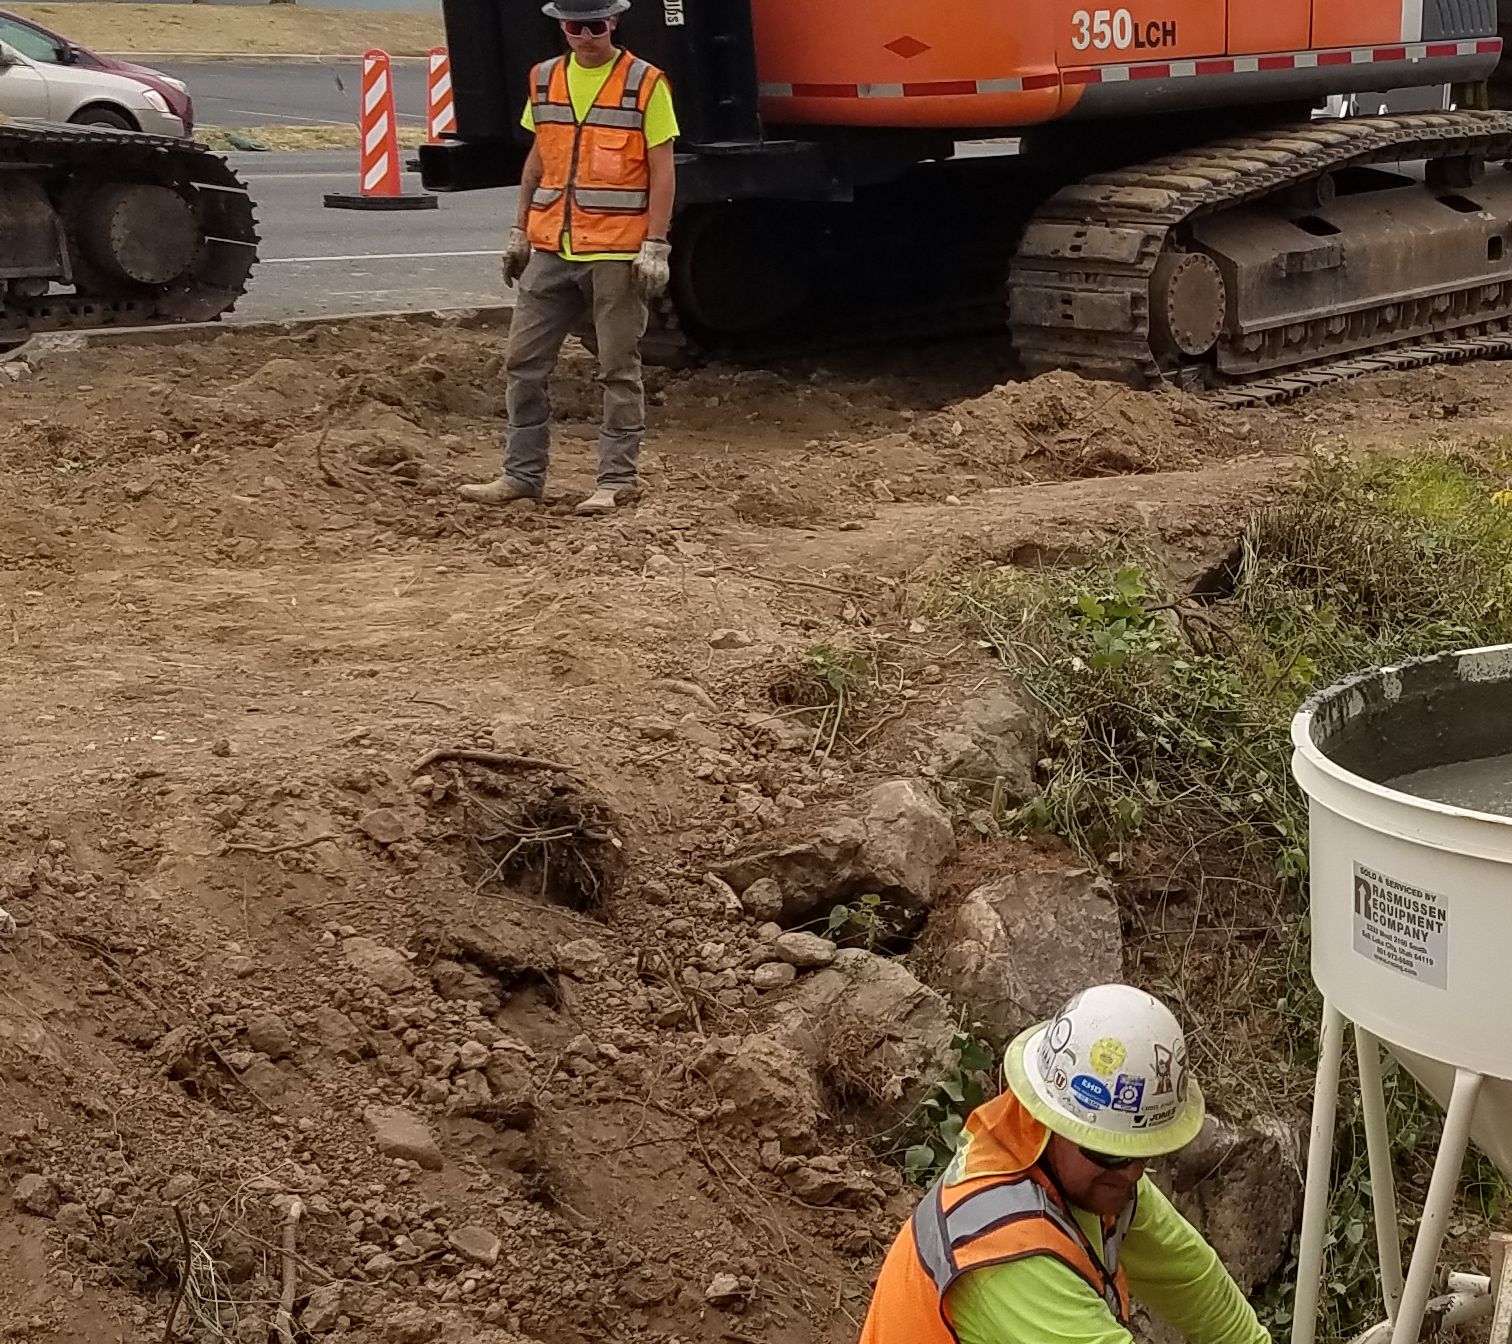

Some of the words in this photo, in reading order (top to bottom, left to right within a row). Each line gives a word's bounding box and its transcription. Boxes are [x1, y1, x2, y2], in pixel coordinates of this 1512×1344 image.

[1373, 884, 1446, 921] RASMUSSEN
[1385, 878, 1422, 898] SERVICED
[1425, 893, 1436, 902] BY
[1373, 898, 1443, 933] EQUIPMENT
[1373, 912, 1428, 942] COMPANY
